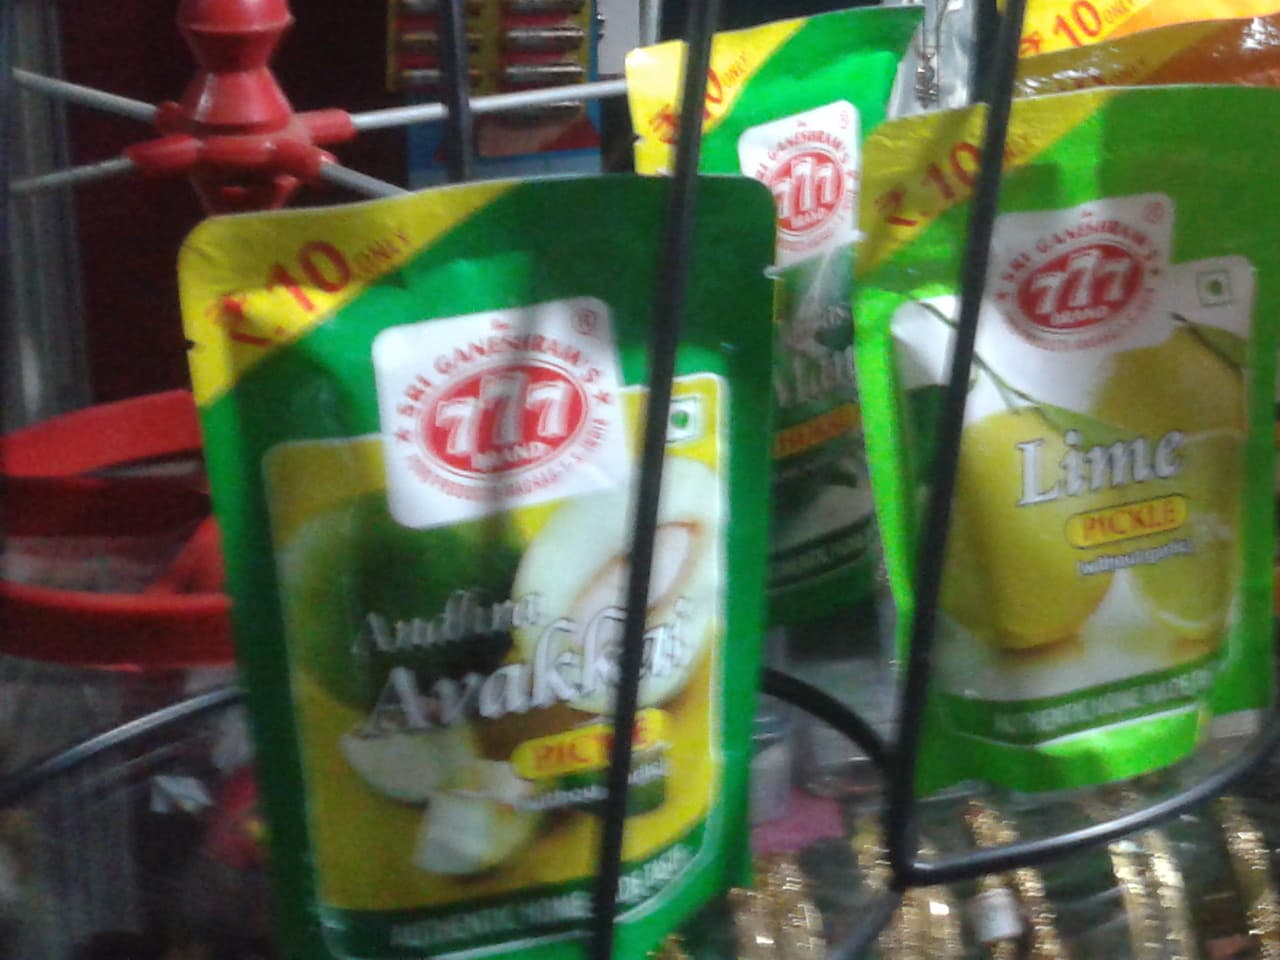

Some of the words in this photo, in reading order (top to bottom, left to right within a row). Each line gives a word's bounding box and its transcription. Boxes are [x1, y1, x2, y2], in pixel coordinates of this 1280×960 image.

[1052, 0, 1102, 48] 10
[264, 240, 352, 313] 10
[1031, 247, 1134, 316] 777
[433, 369, 575, 456] 777
[1014, 428, 1185, 507] Lime
[1082, 498, 1177, 540] PICKLE
[531, 716, 649, 764] PICE
